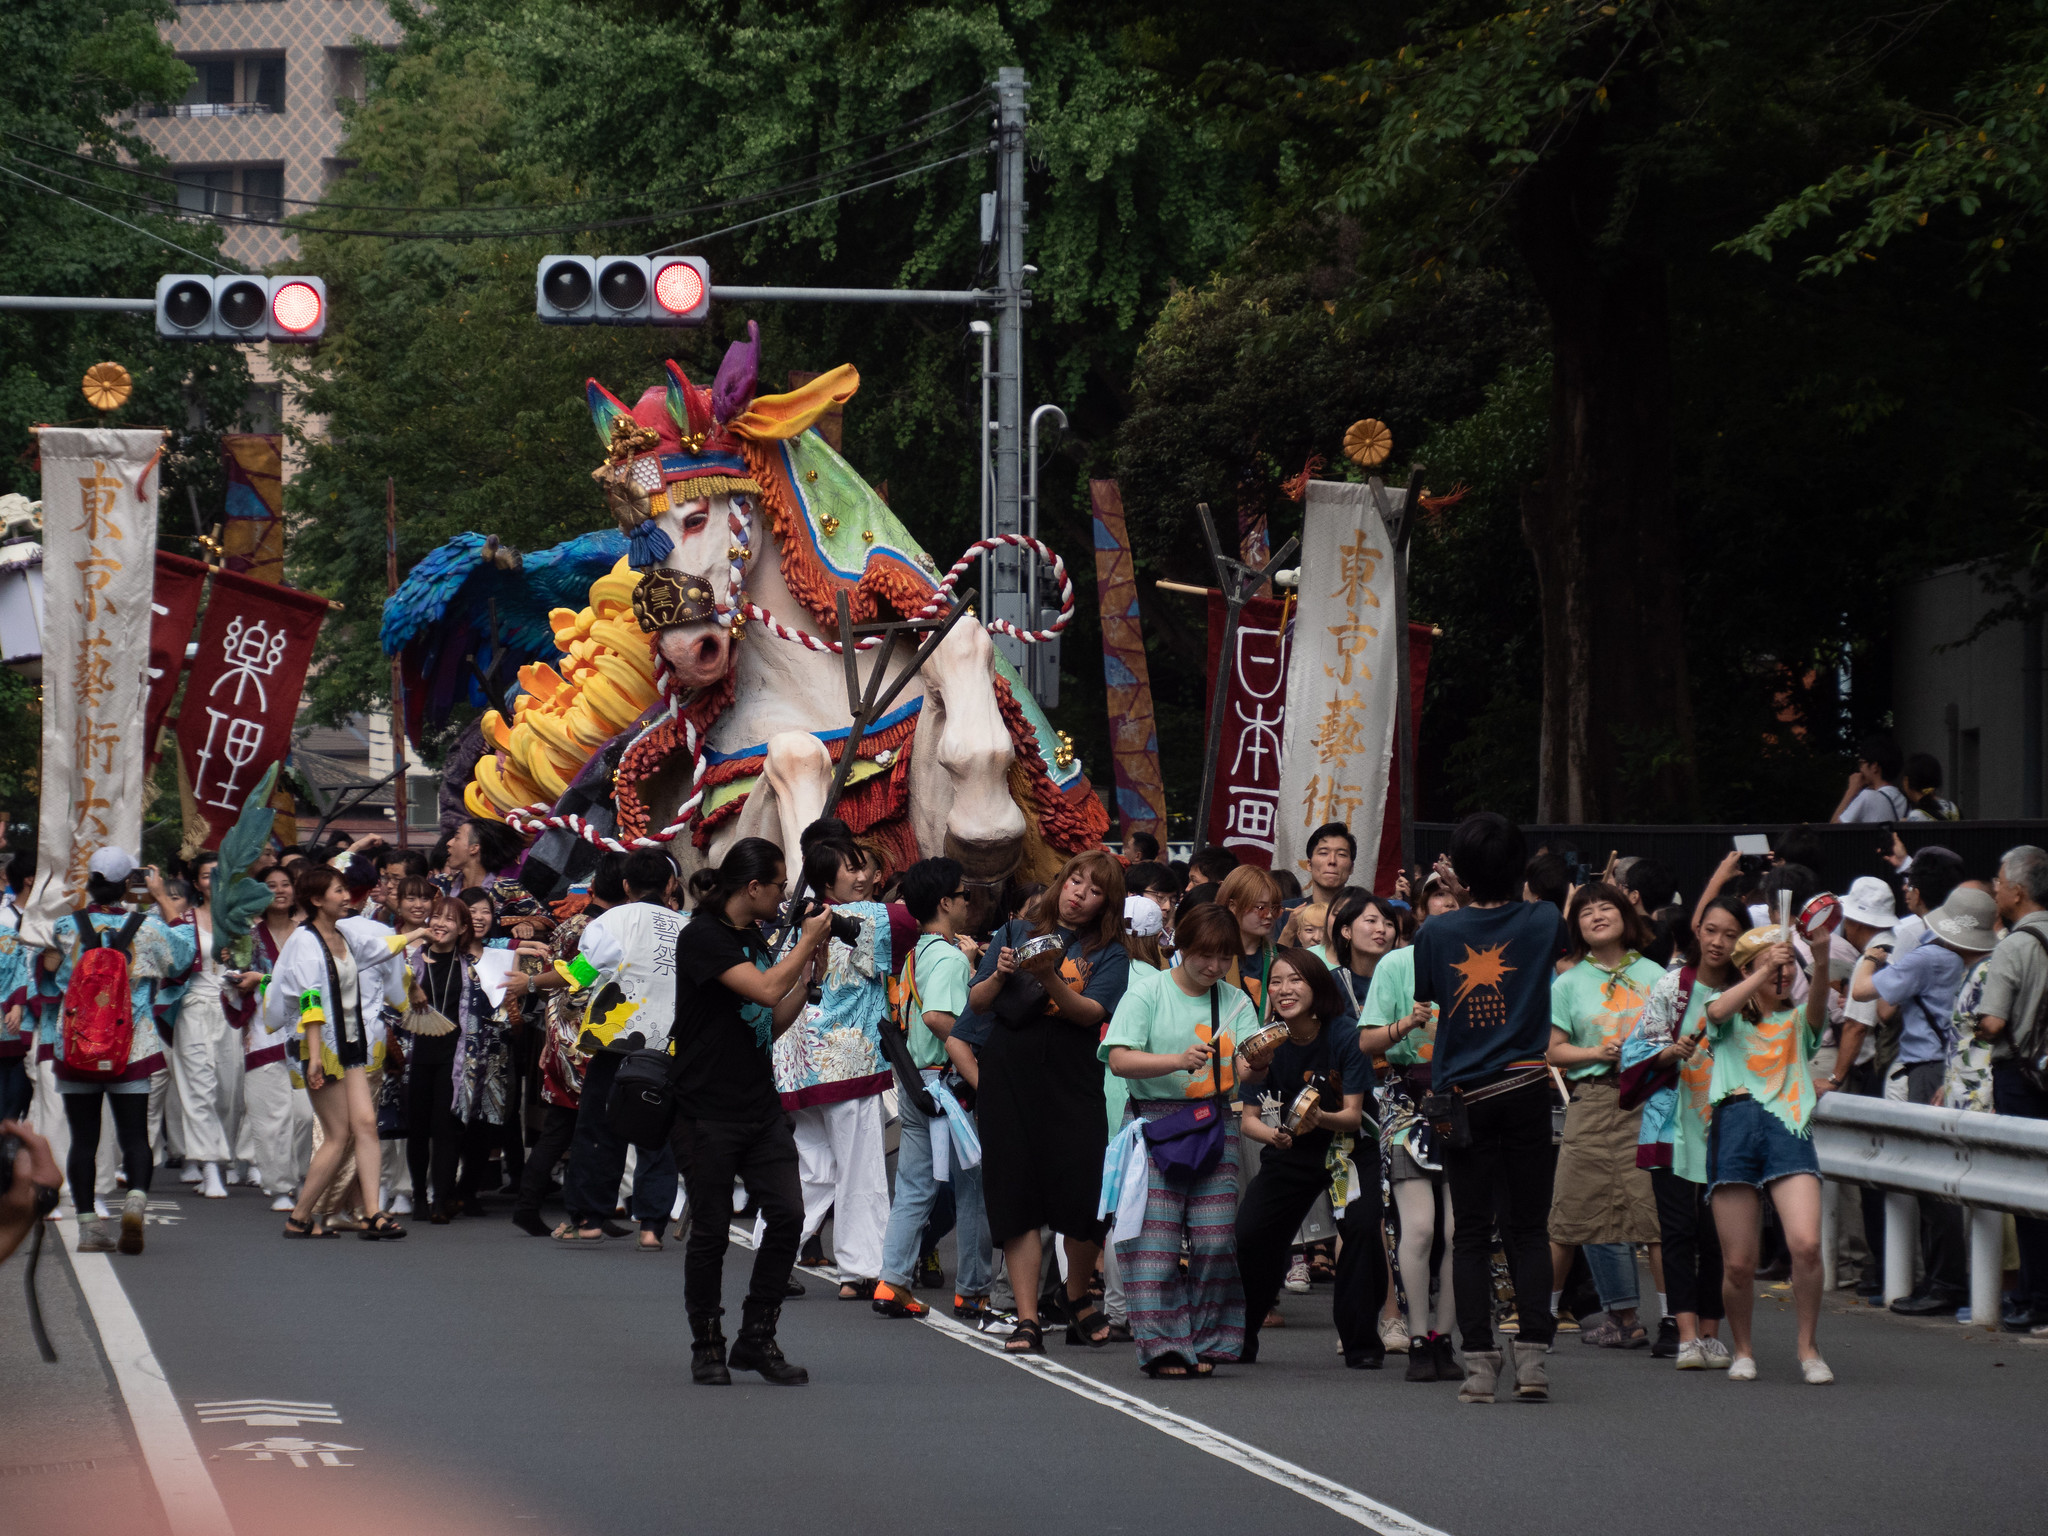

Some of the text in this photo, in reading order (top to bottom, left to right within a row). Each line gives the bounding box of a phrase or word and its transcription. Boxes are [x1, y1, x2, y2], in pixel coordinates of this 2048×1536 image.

[1297, 529, 1383, 890] 東京藝術
[651, 911, 680, 976] 藝祭
[1468, 994, 1505, 1003] GEIDAI
[1468, 1002, 1506, 1012] SAMBA
[1469, 1010, 1506, 1019] PARTY
[1469, 1018, 1506, 1028] 2019
